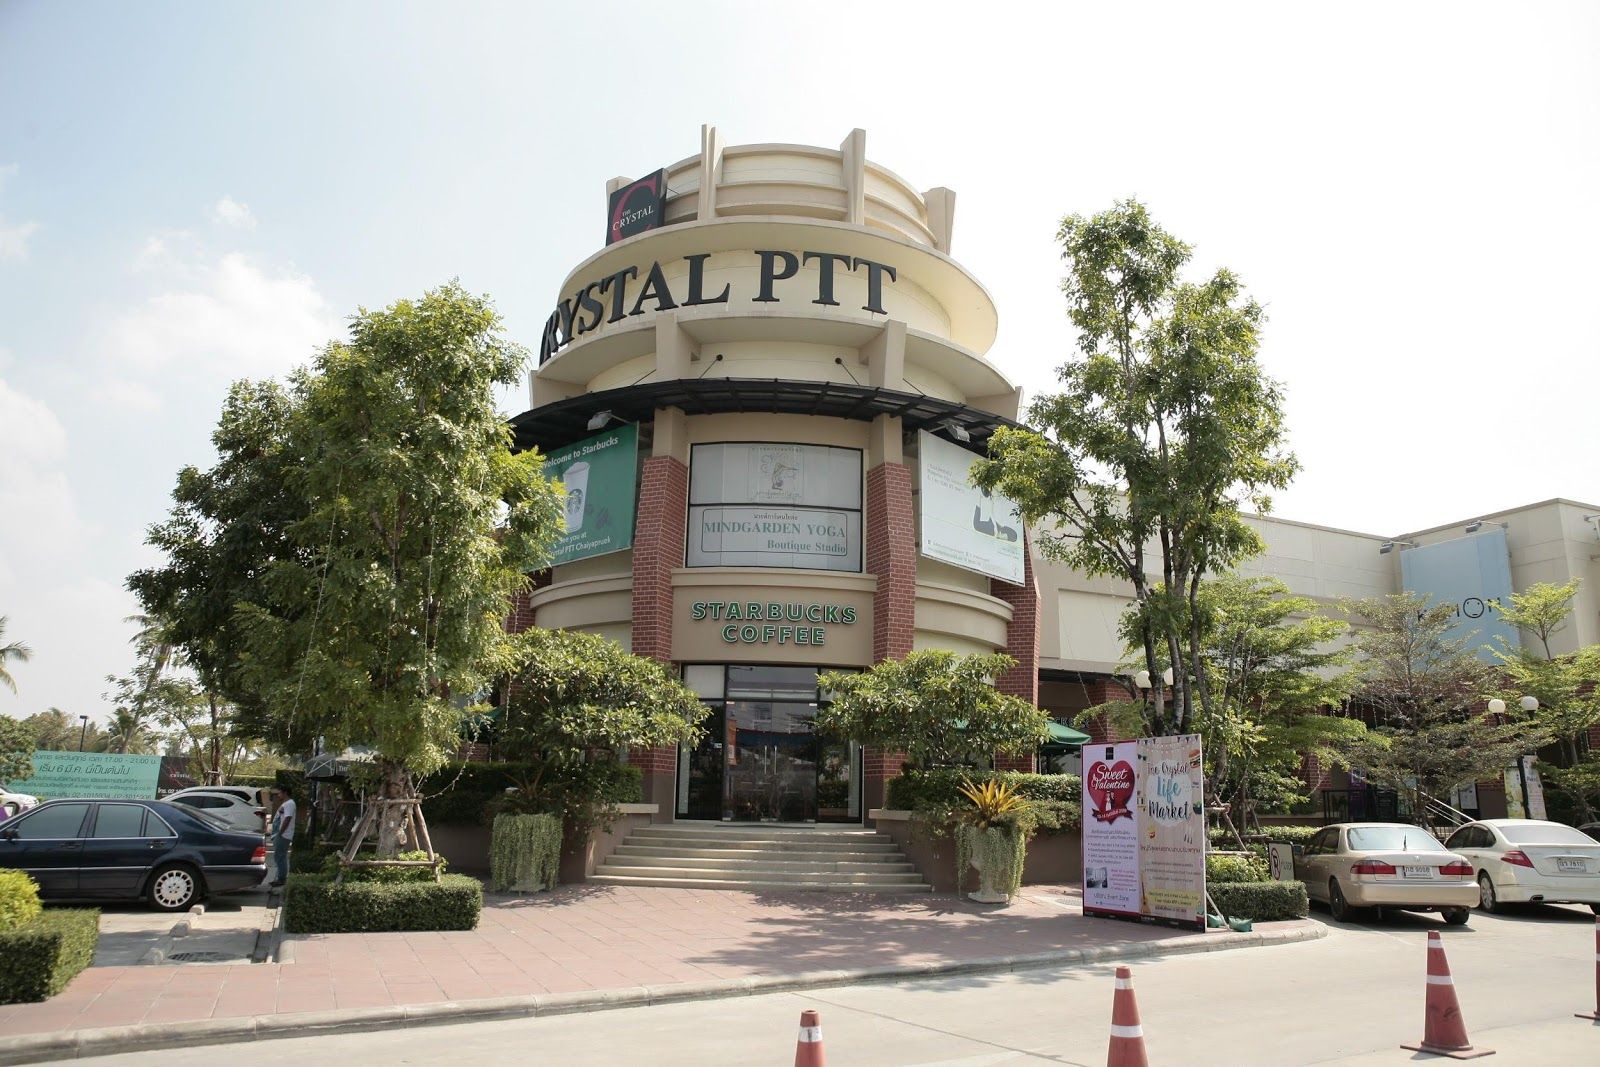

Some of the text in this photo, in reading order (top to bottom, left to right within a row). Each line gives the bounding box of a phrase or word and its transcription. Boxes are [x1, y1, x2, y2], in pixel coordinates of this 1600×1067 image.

[612, 205, 654, 231] CRYSTAL
[539, 249, 897, 368] RYSTAL PTT
[573, 450, 581, 459] to
[582, 436, 619, 455] Starbucks
[580, 531, 587, 539] at
[703, 521, 846, 538] MINDGARDEN YOGA
[767, 539, 846, 554] Boutique Studio
[691, 601, 857, 624] STARBUCKS
[721, 624, 826, 645] COFFEE
[1096, 764, 1128, 781] Sweet
[1161, 761, 1188, 780] Crystal
[1090, 773, 1131, 790] Valentine
[1148, 799, 1191, 820] Market
